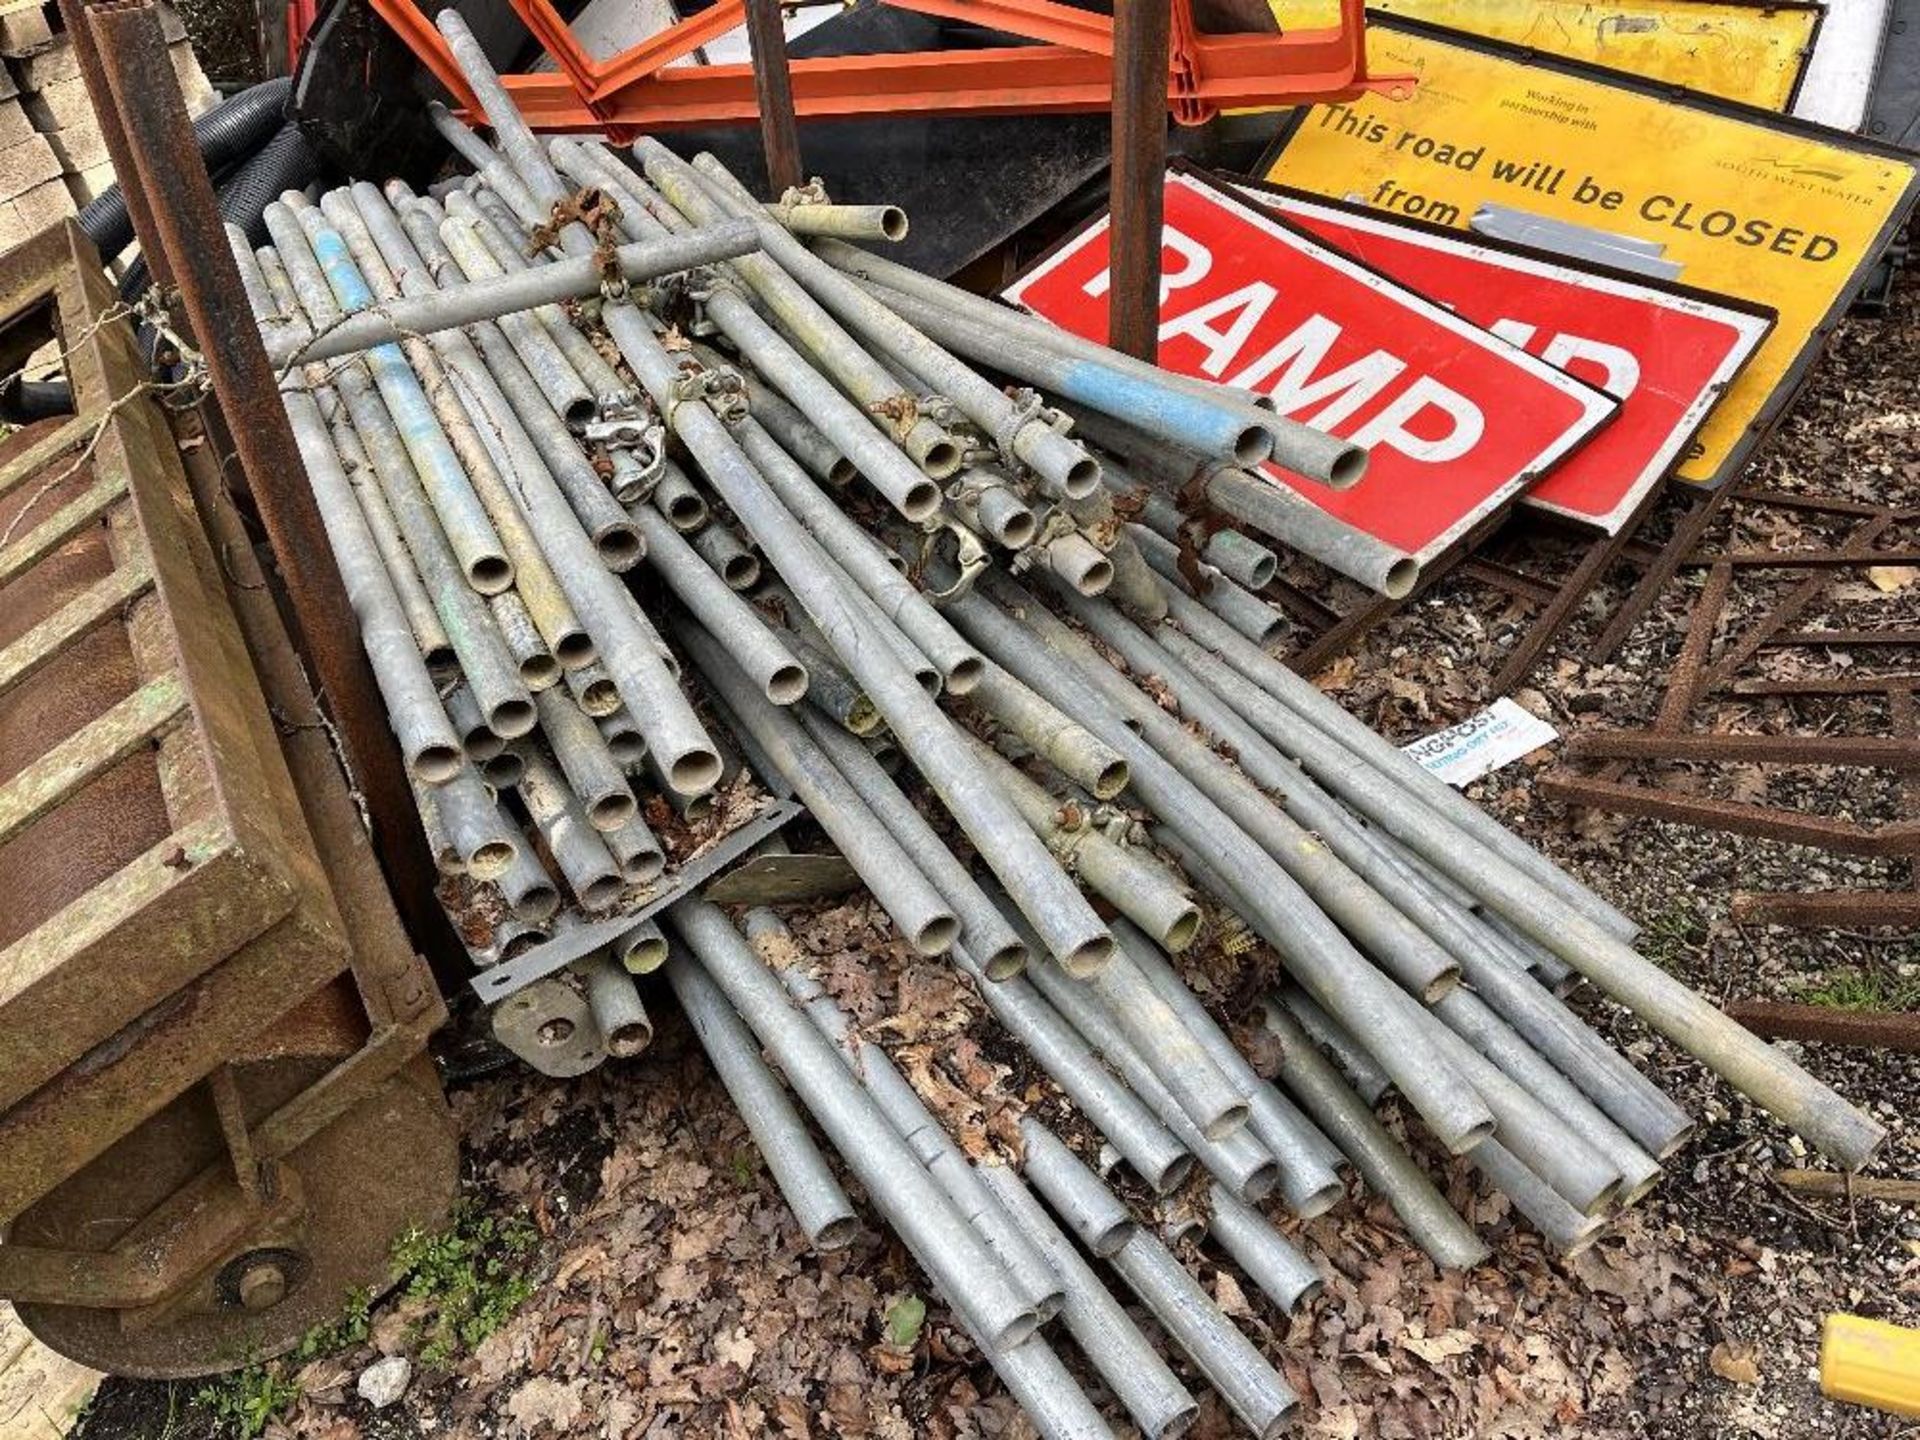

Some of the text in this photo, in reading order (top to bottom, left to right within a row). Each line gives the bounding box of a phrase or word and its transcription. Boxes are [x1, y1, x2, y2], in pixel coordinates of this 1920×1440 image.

[1499, 98, 1598, 132] partnership with
[1524, 88, 1590, 113] Working in
[1319, 103, 1839, 262] This road will be CLOSED
[1371, 179, 1461, 226] from
[1714, 159, 1874, 207] SOUTH WEST WATER
[1081, 223, 1486, 464] RAMP
